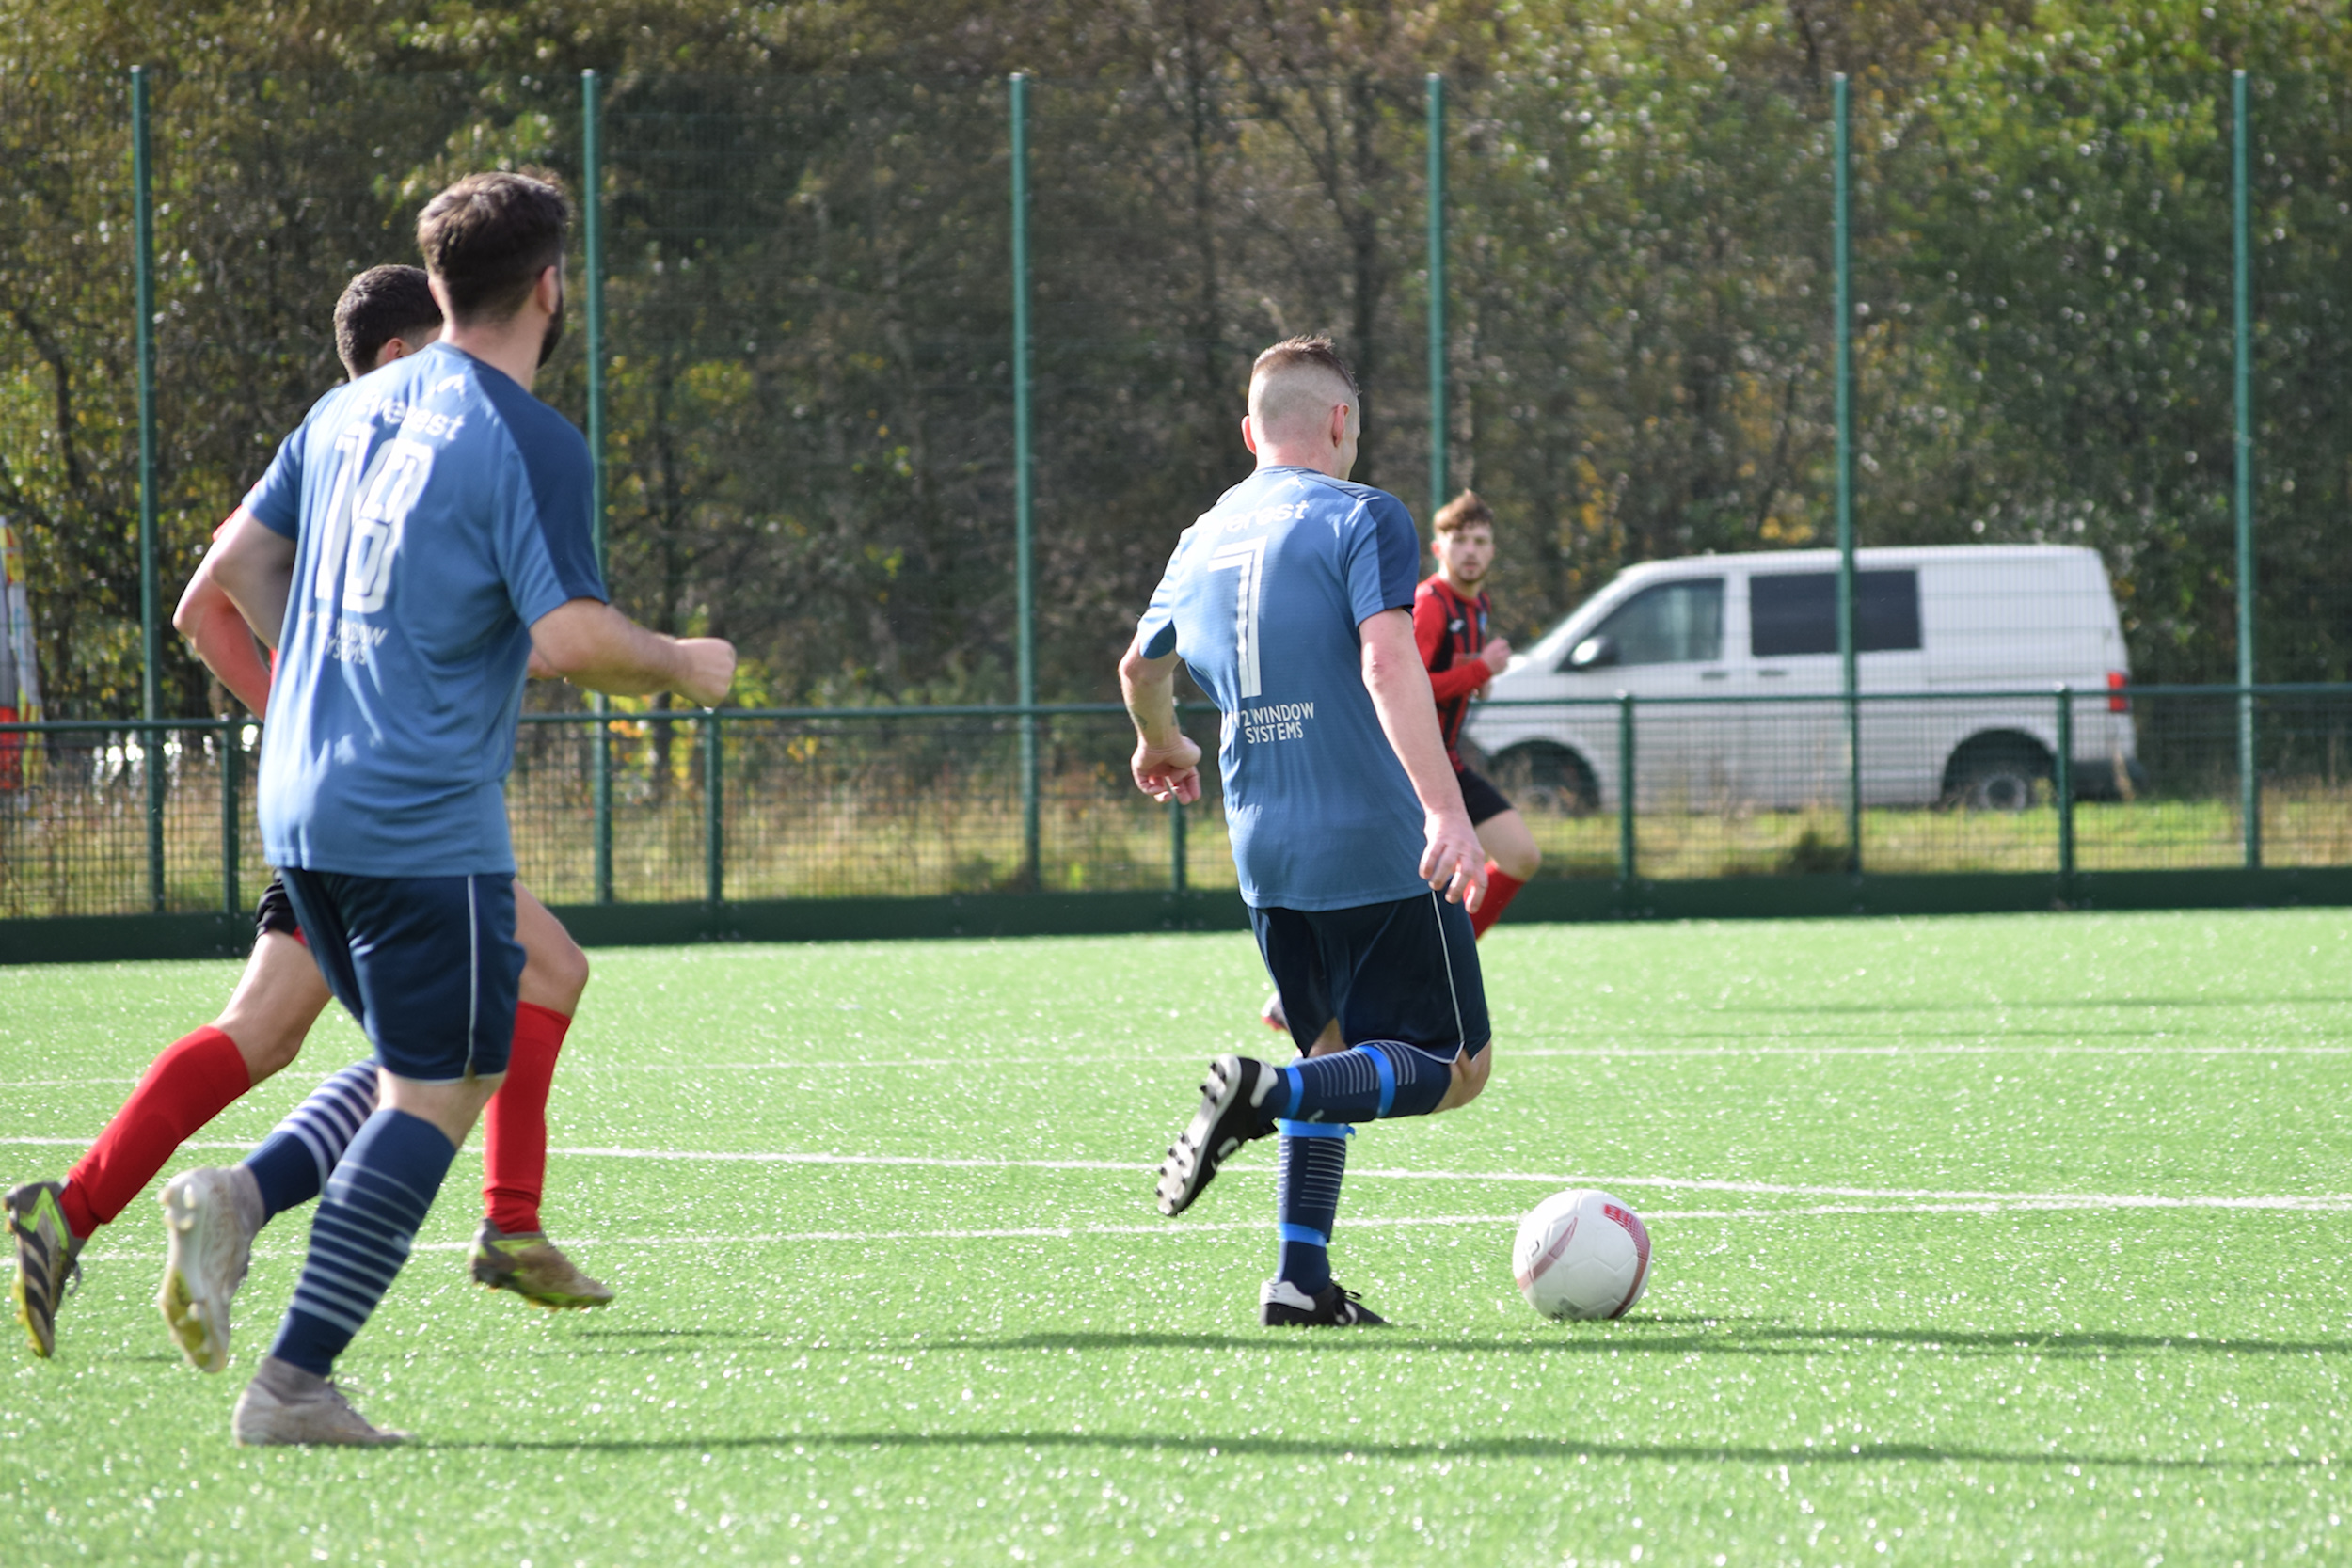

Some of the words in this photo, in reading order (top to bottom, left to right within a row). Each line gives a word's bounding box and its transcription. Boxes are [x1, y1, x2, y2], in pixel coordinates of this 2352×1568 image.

[1207, 535, 1268, 699] 7
[1250, 702, 1314, 725] WINDOW
[1245, 721, 1304, 744] SYSTEMS
